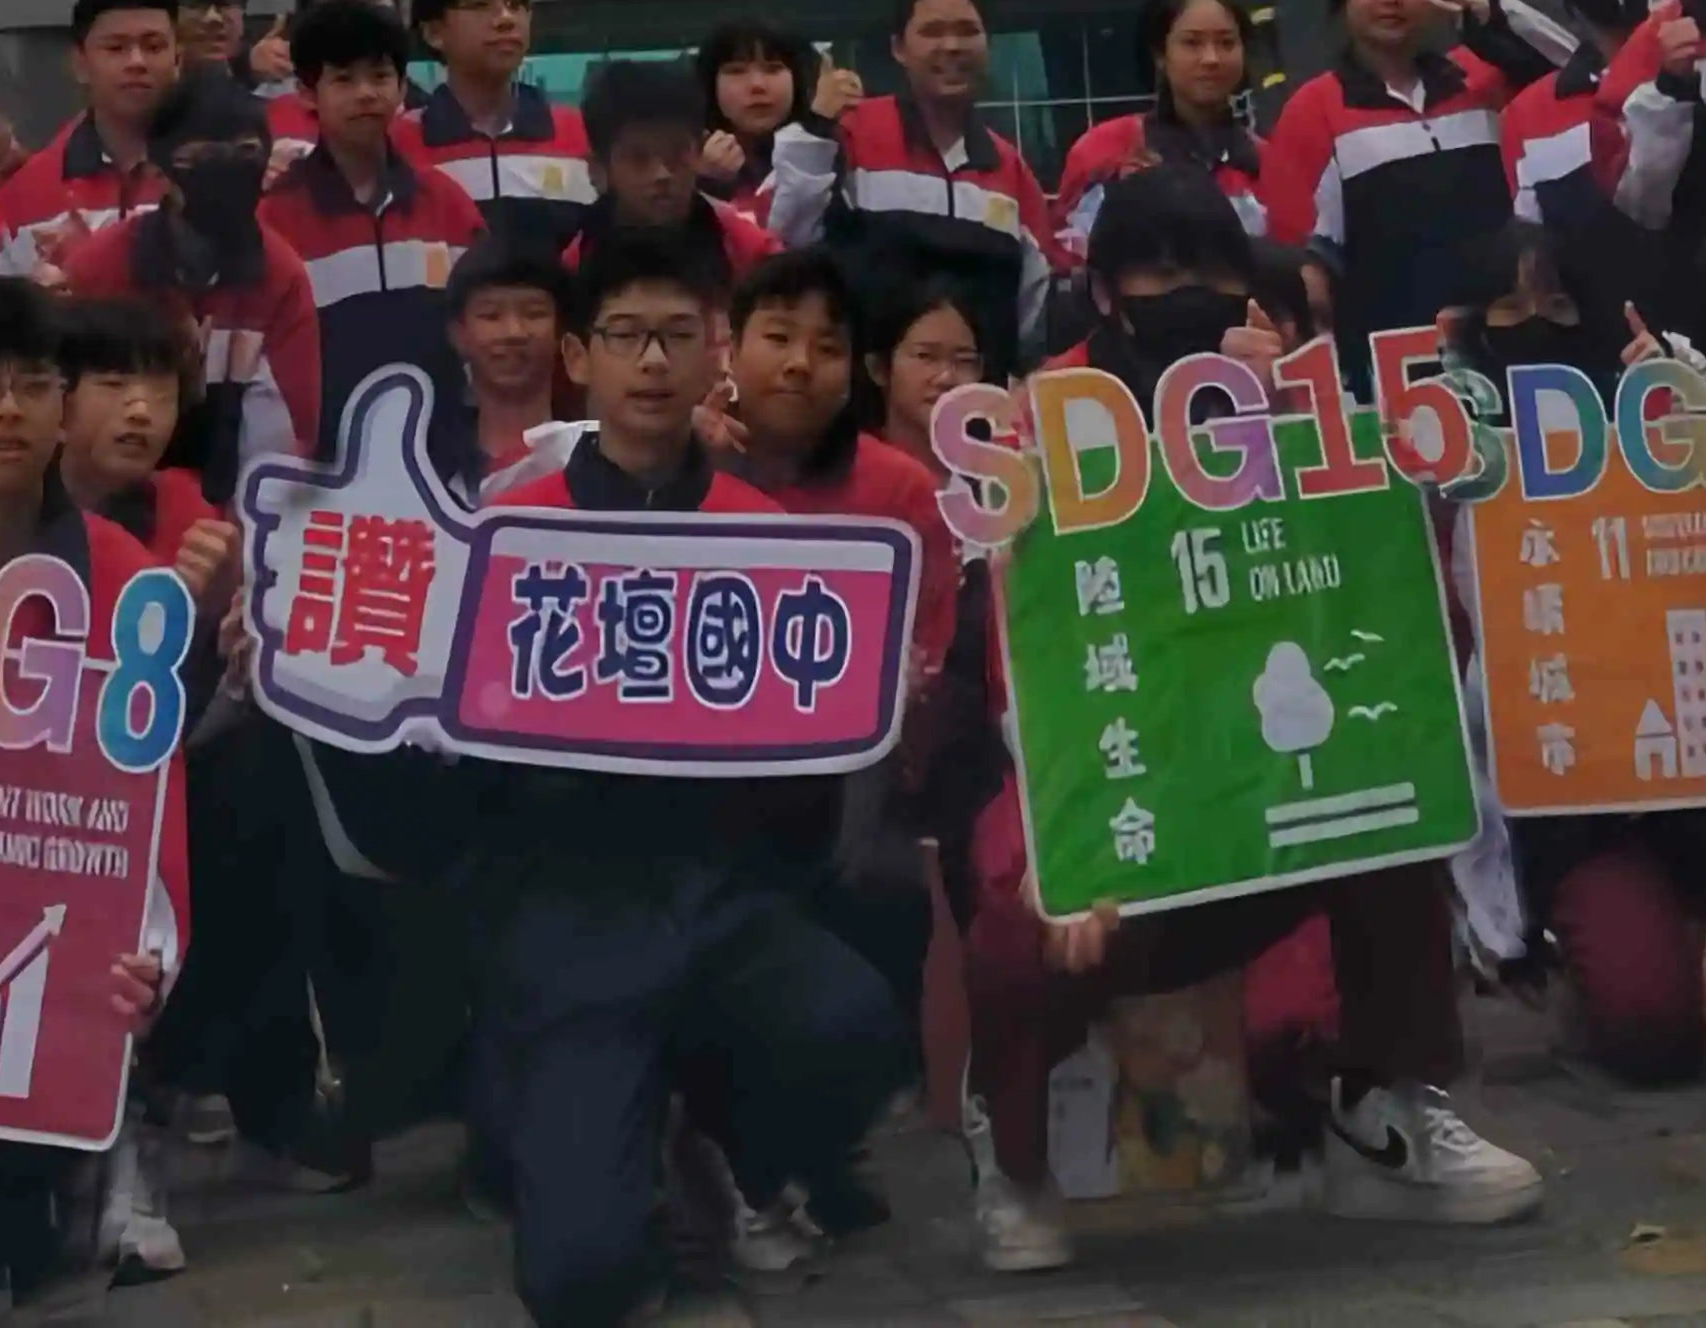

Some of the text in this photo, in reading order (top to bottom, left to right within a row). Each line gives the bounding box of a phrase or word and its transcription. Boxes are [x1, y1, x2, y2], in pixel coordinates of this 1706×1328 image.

[930, 325, 1475, 549] SDG15
[285, 509, 436, 678] 讚
[1170, 517, 1286, 615] 15 LIFE
[1591, 515, 1631, 581] 11
[508, 562, 853, 713] 花壇國中
[1073, 554, 1157, 867] 陸域生命
